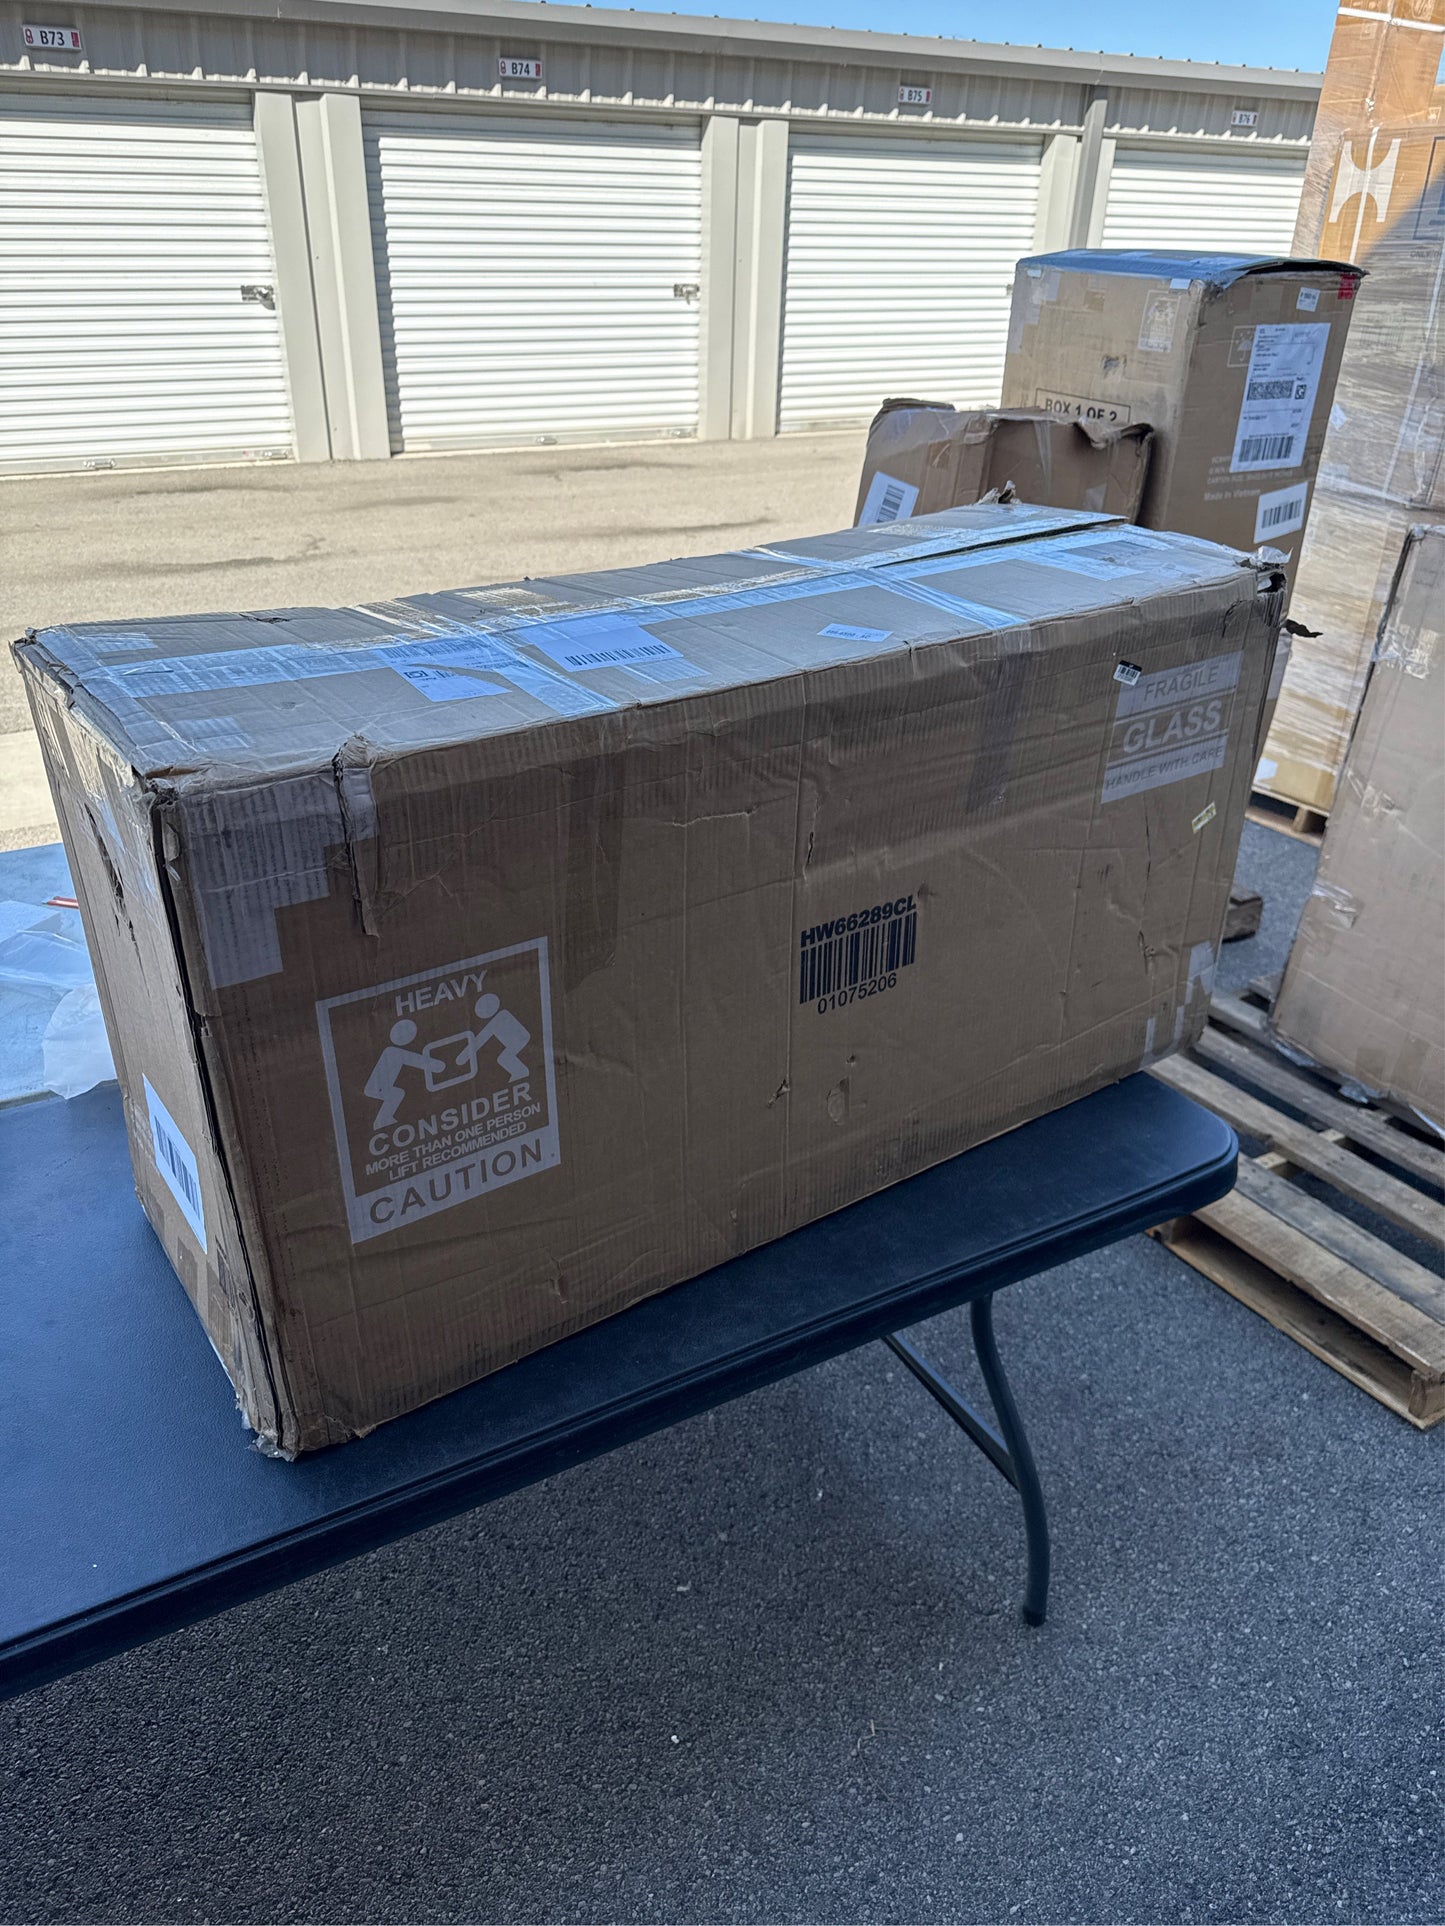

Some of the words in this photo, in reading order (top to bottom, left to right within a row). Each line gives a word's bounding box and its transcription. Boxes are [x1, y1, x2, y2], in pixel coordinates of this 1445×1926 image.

[40, 30, 65, 46] B73
[511, 62, 530, 75] B74
[907, 89, 922, 102] B75
[1045, 398, 1071, 415] BOX
[1075, 403, 1082, 416] 1
[1086, 406, 1105, 420] OF
[1109, 410, 1118, 422] 2
[1144, 665, 1219, 701] FRAGILE
[1123, 699, 1222, 753] GLASS
[1106, 764, 1158, 790] HANDLE
[1158, 757, 1189, 774] WITH
[1191, 745, 1224, 764] CARE
[800, 894, 917, 948] HW66289CL
[395, 969, 488, 1017] HEAVY
[817, 972, 897, 1015] 01075206
[365, 1151, 410, 1176] MORE
[412, 1134, 452, 1159] THAN
[454, 1122, 485, 1143] ONE
[486, 1102, 541, 1131] PERSON
[368, 1081, 532, 1156] CONSIDER
[388, 1160, 419, 1182] LIFT
[422, 1121, 527, 1170] RECOMMENDED
[369, 1138, 542, 1224] CAUTION
